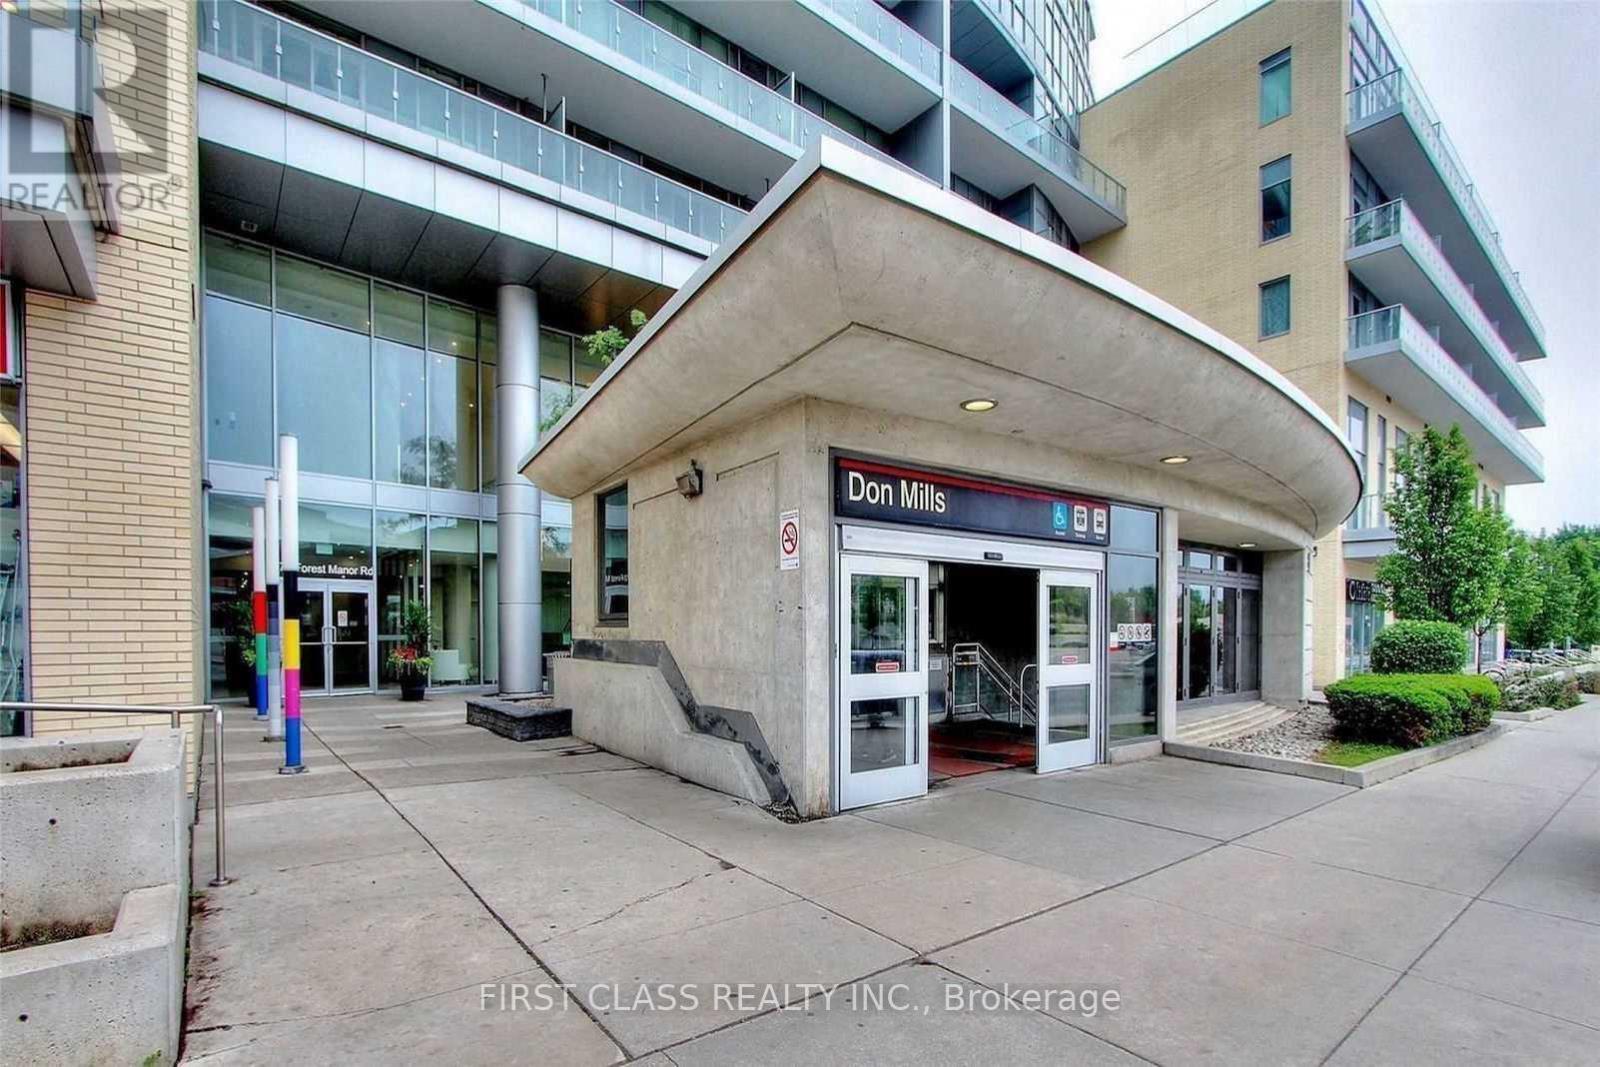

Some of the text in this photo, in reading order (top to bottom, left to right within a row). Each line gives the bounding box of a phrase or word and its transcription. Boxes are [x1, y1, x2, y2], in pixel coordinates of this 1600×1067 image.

[848, 471, 946, 513] Don Mills
[328, 564, 358, 575] Manor
[360, 566, 374, 576] Rd
